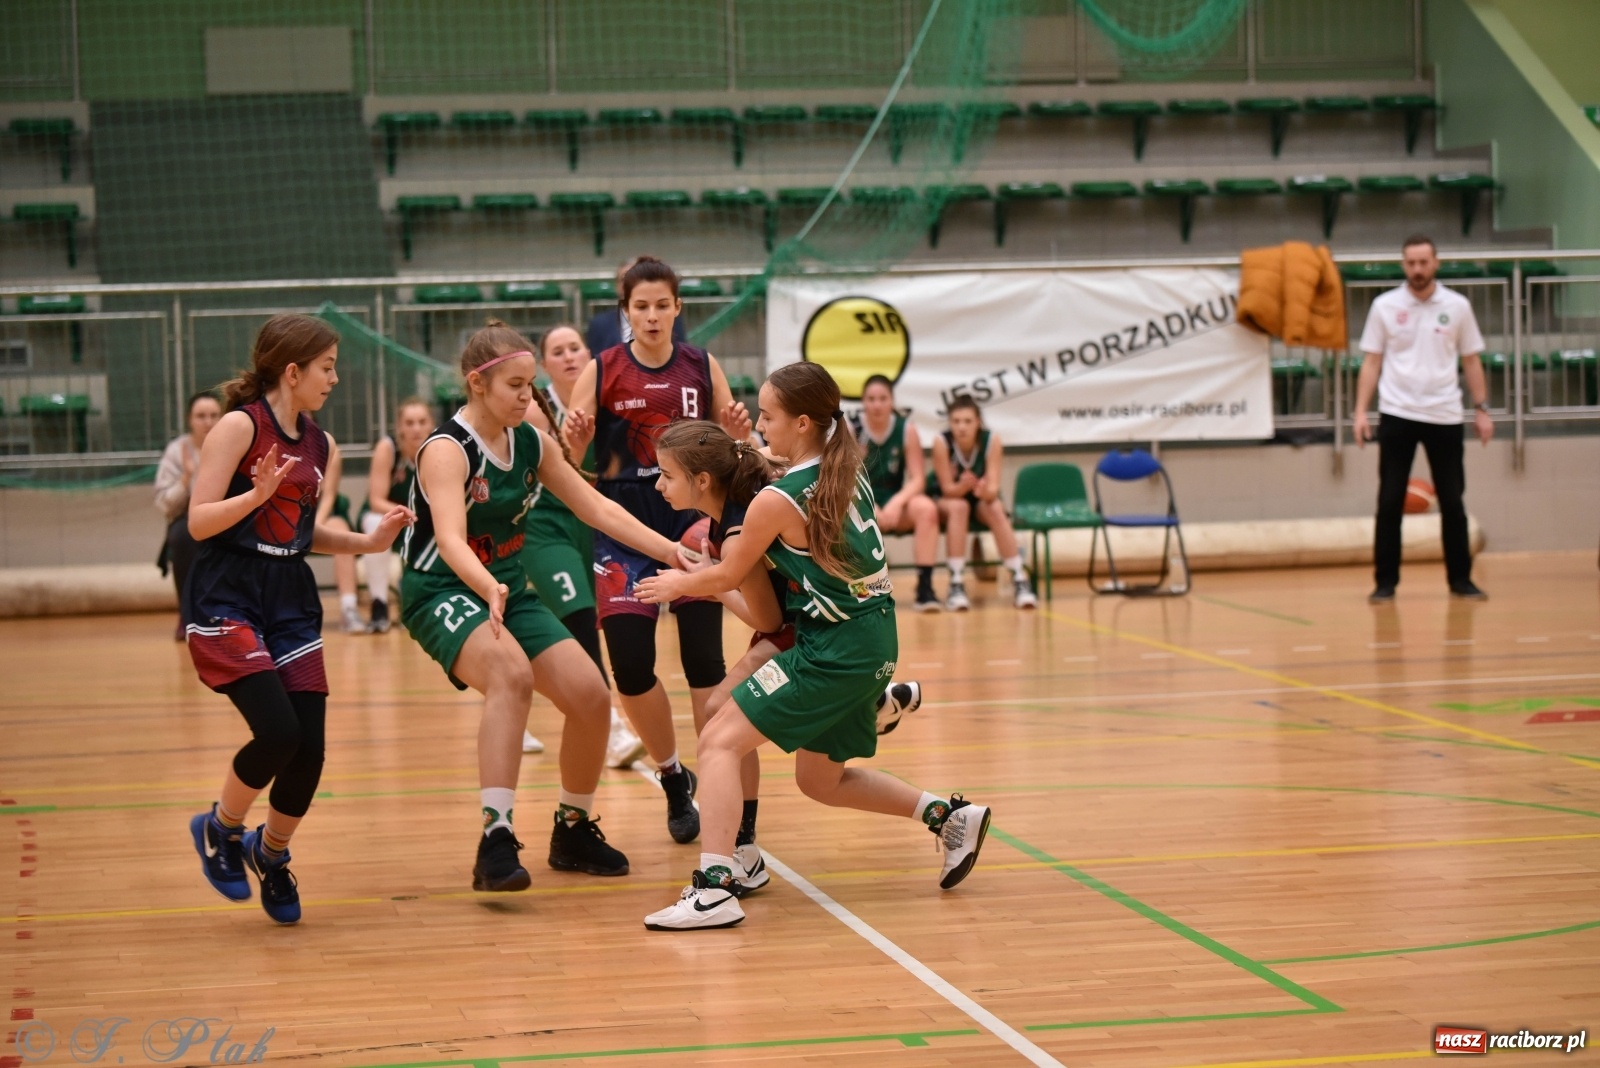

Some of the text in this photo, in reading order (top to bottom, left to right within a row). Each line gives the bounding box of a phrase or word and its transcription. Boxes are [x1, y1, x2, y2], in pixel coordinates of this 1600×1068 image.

[681, 386, 699, 419] 13
[936, 368, 1008, 416] JEST
[1016, 357, 1048, 387] W
[552, 571, 577, 602] 3
[433, 594, 481, 633] 23
